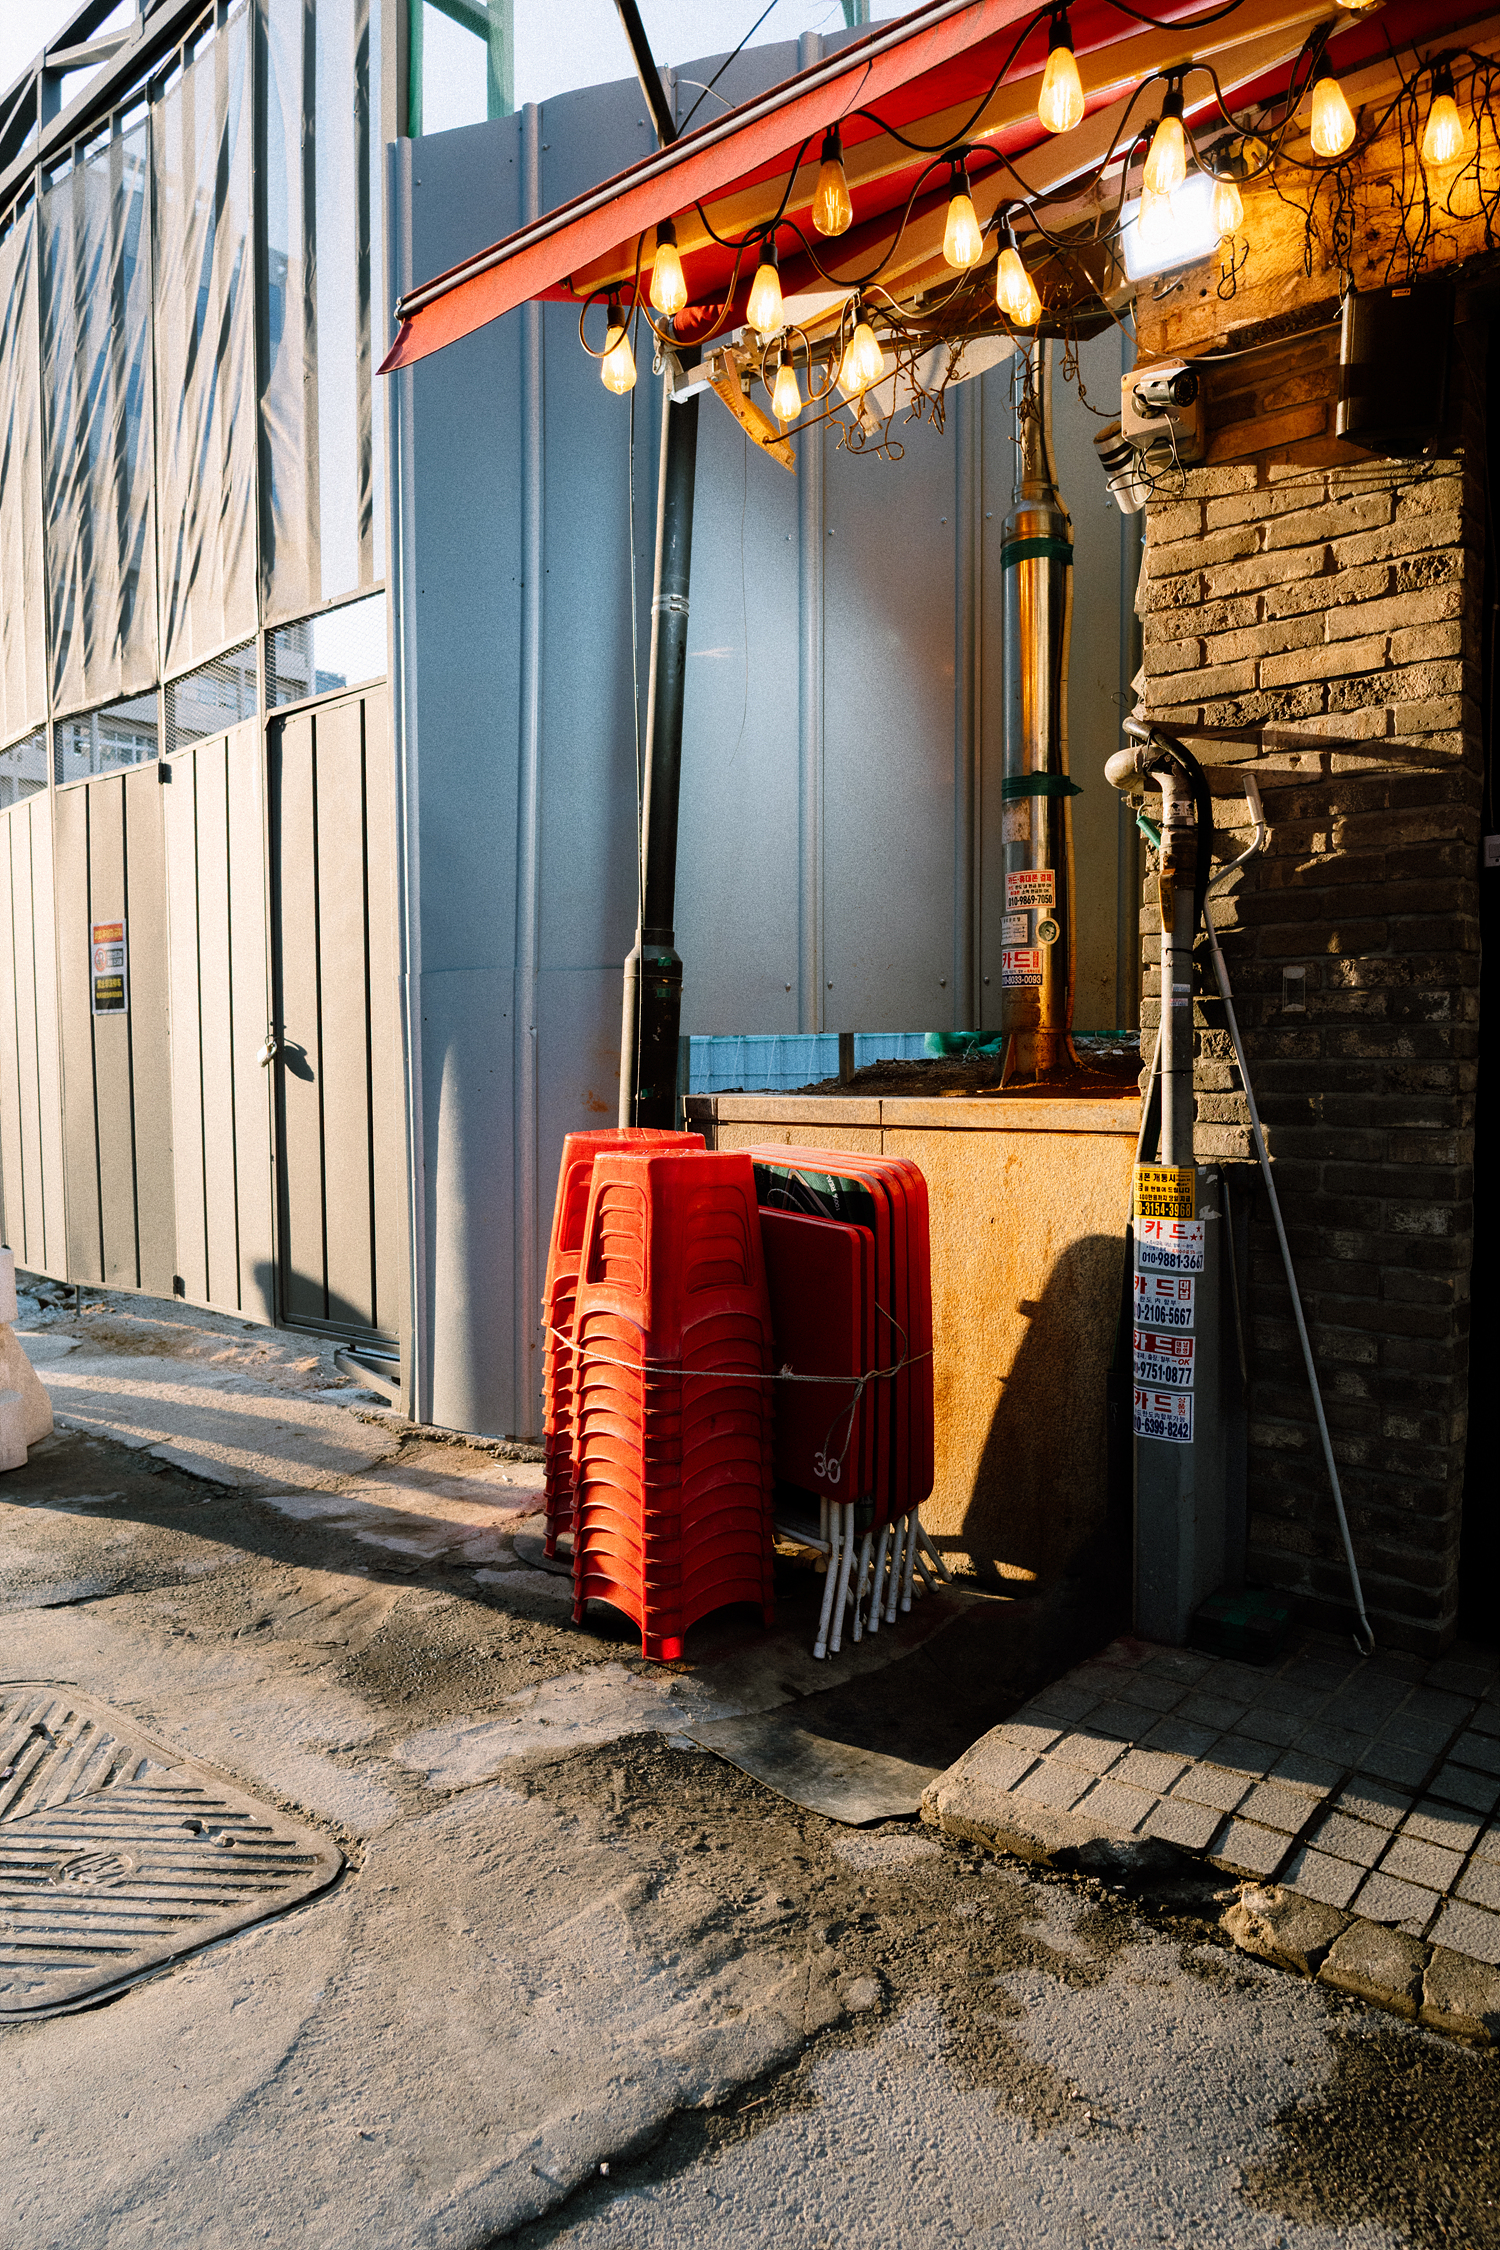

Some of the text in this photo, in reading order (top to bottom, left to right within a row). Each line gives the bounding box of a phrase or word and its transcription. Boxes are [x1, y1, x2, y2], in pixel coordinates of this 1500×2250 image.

[1008, 894, 1053, 907] 010-9869-7050
[1002, 951, 1031, 970] 카드
[1153, 1173, 1176, 1183] 개통시
[1144, 1220, 1189, 1240] 카드
[1134, 1275, 1175, 1298] 카드
[1134, 1331, 1173, 1355] 카드
[1177, 1358, 1191, 1366] OK
[1134, 1389, 1172, 1414] 카드
[813, 1451, 841, 1484] 30
